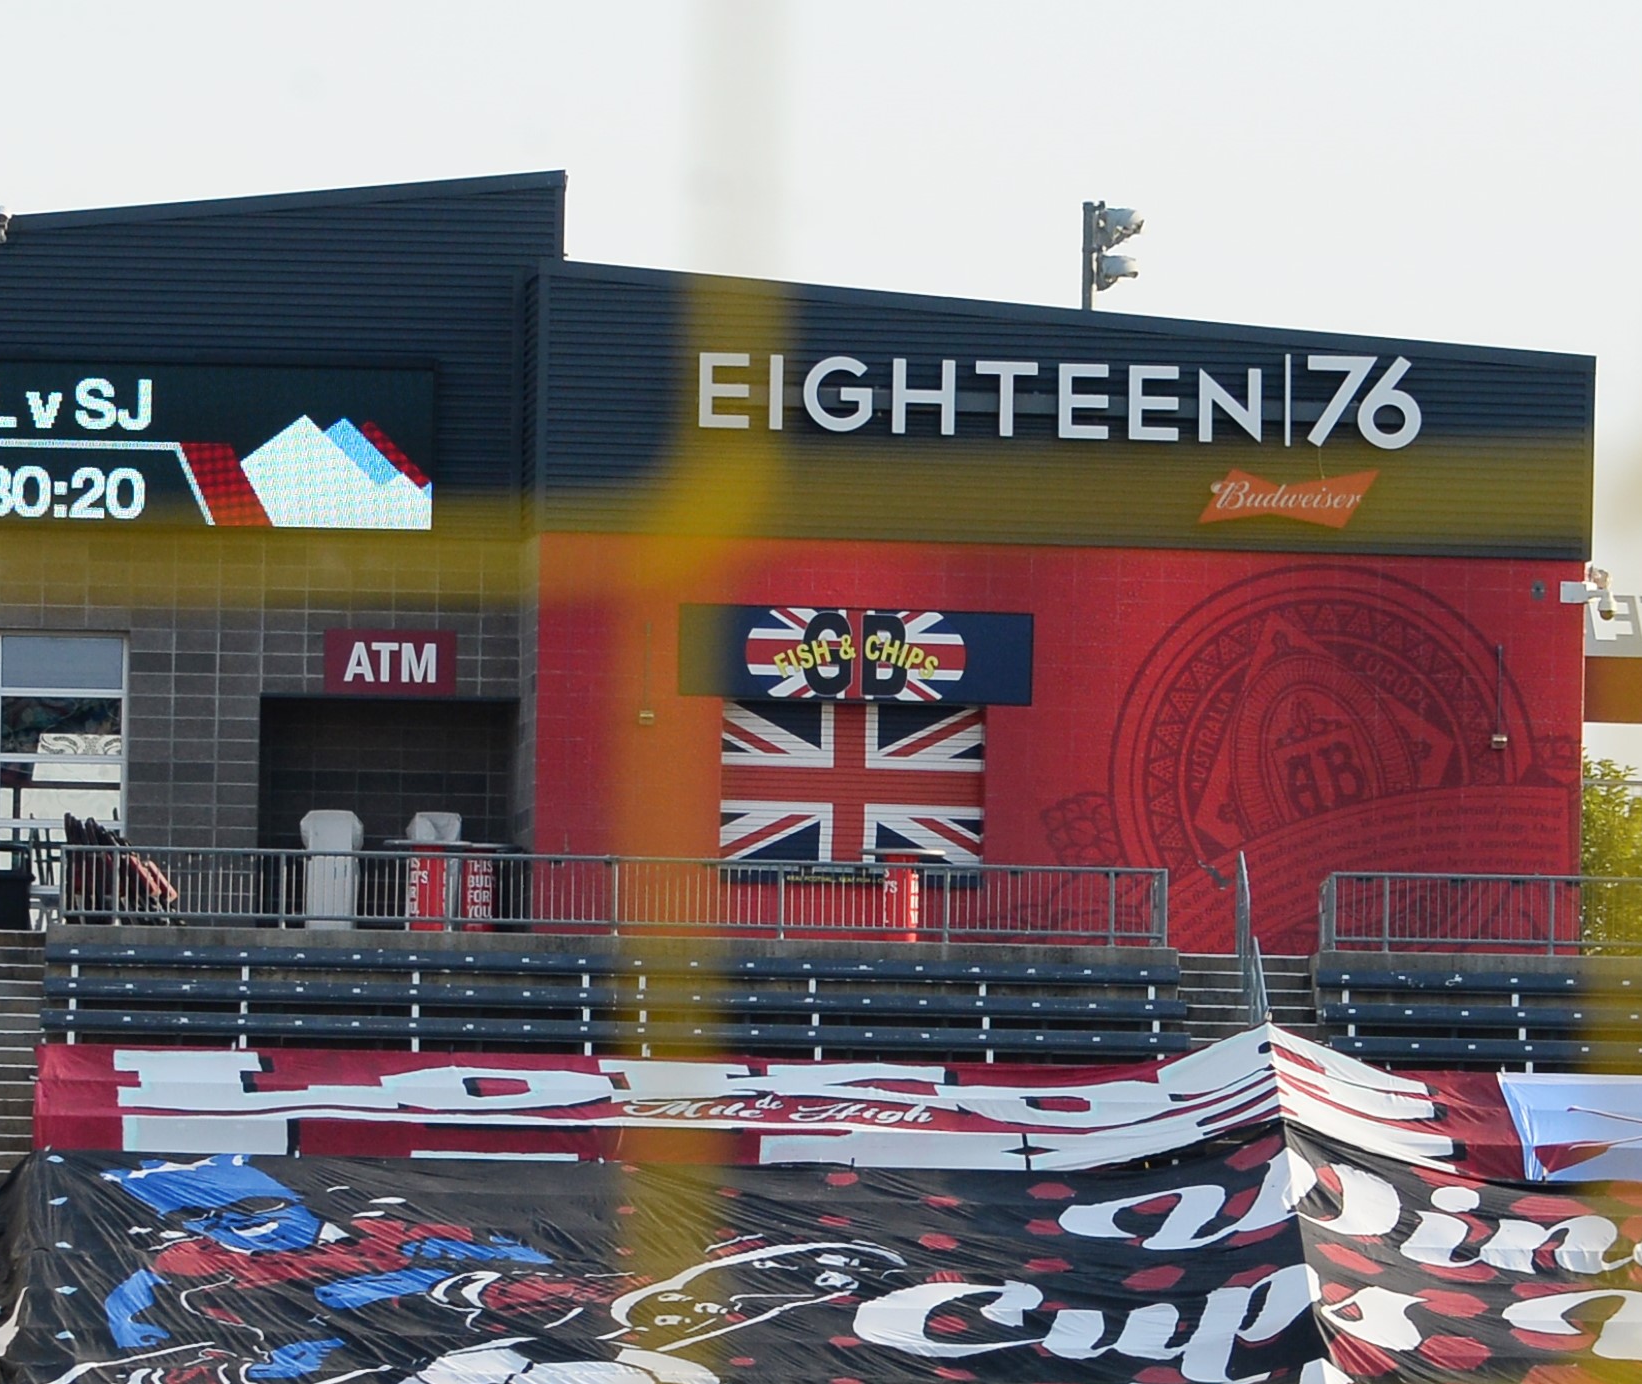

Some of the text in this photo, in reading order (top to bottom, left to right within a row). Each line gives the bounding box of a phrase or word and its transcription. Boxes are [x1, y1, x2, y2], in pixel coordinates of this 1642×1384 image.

[25, 390, 64, 430] v
[75, 377, 155, 431] SJ
[1210, 480, 1362, 510] Budweiser
[343, 640, 438, 685] ATM
[773, 634, 939, 680] FISH & CHIPS
[1285, 729, 1361, 818] AB
[467, 860, 493, 873] THIS
[467, 890, 491, 903] FOR
[622, 1099, 935, 1125] Mile High
[853, 1263, 1427, 1384] Cups
